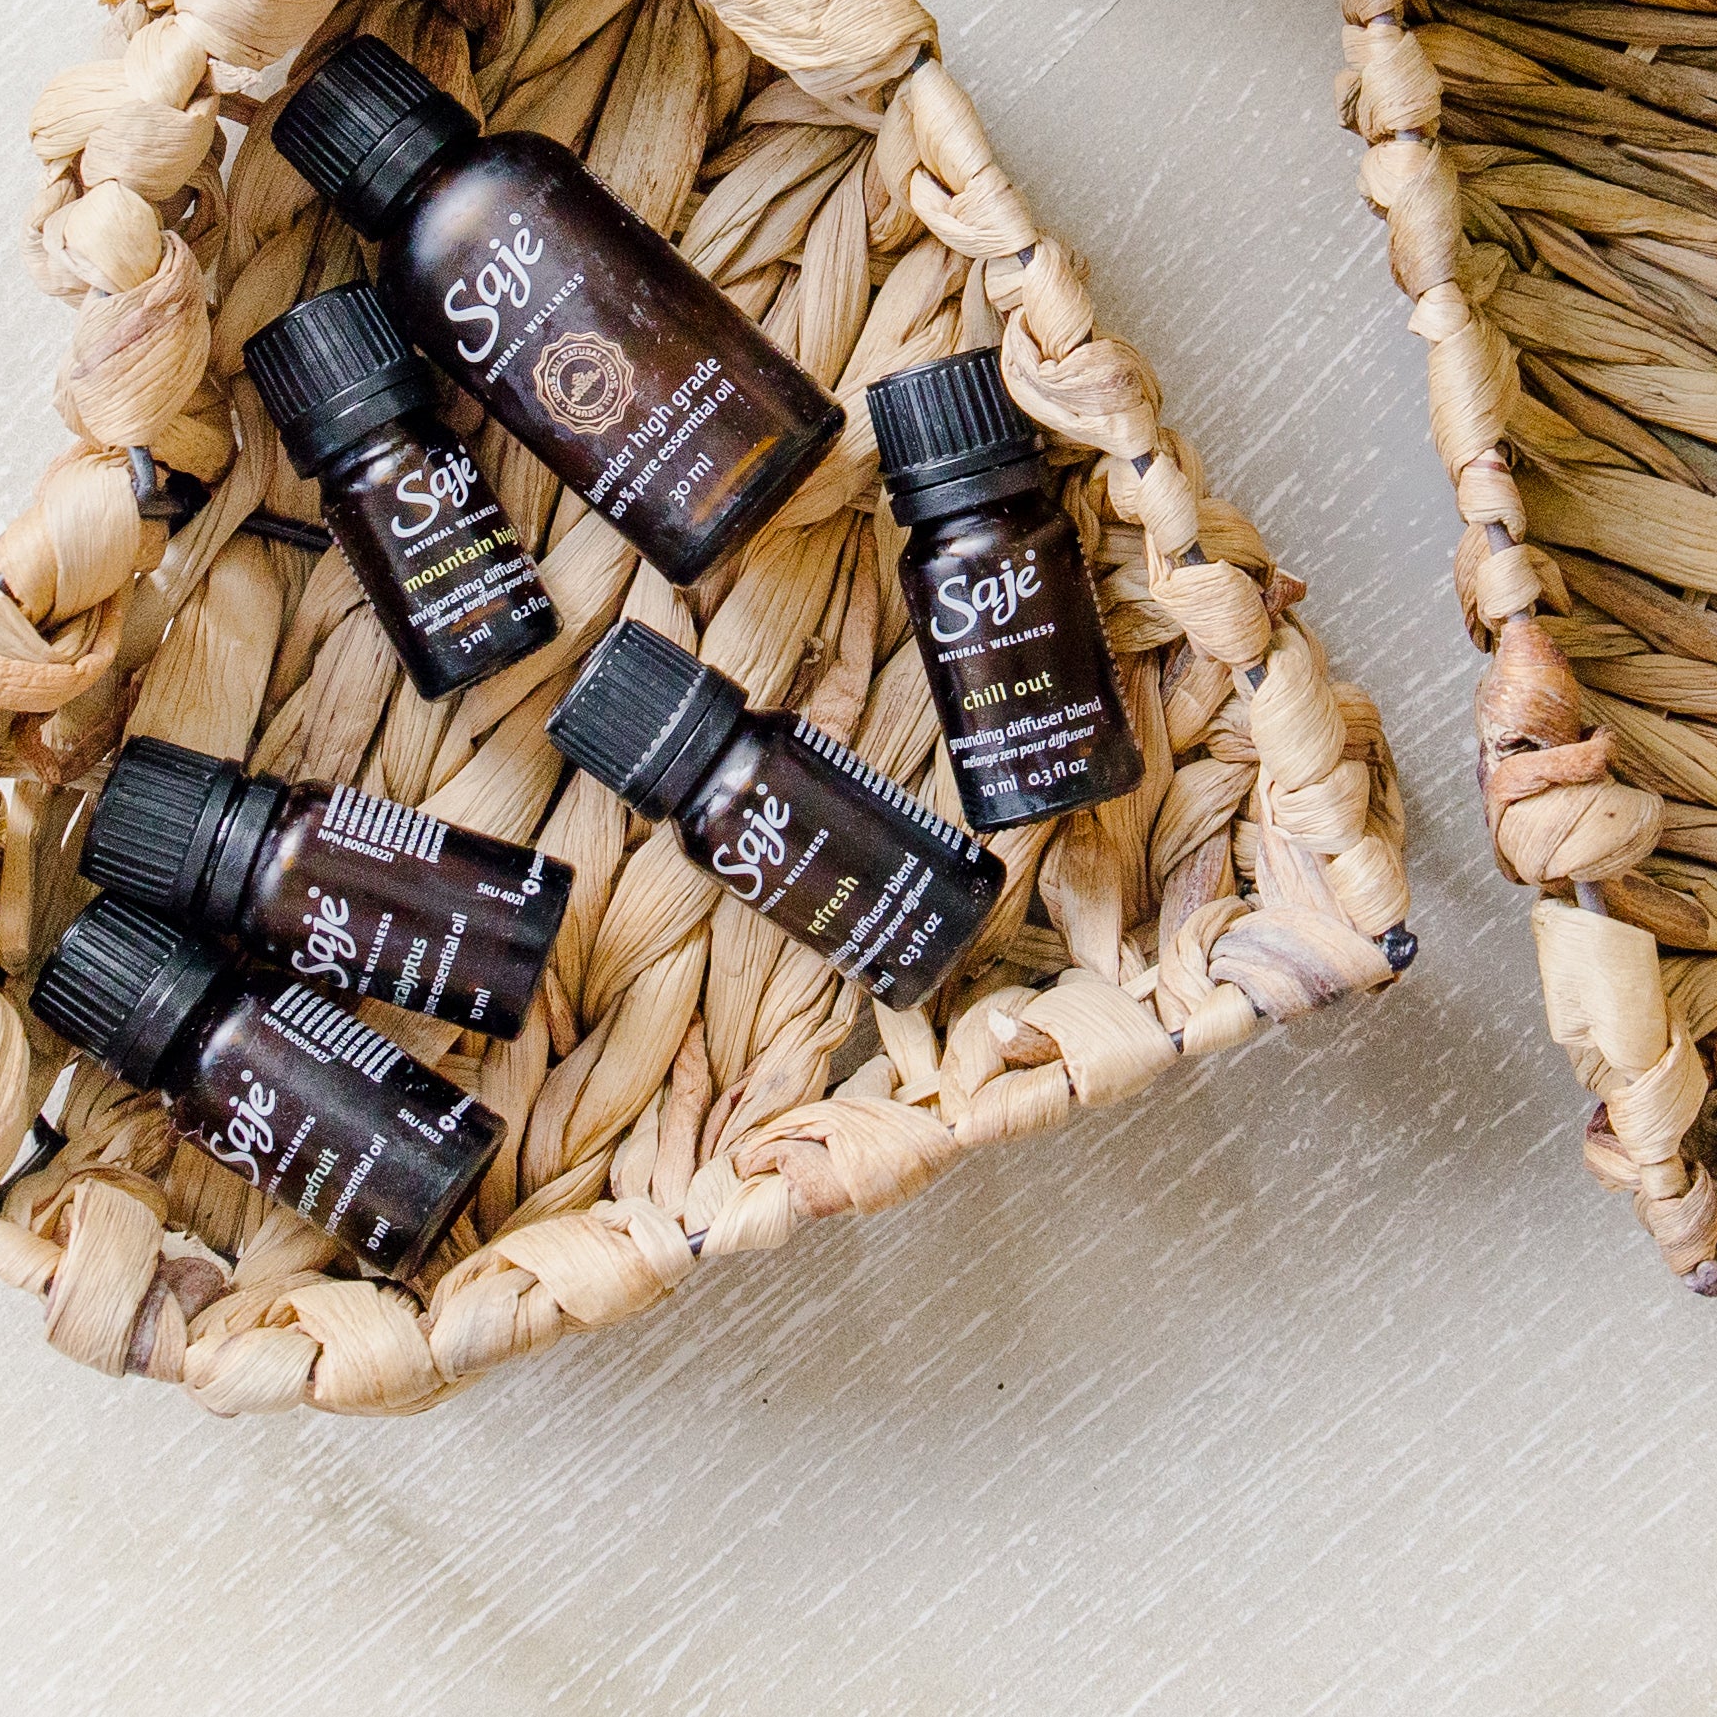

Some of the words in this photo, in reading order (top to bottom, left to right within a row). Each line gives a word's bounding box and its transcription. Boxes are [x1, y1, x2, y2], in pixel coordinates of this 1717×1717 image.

[444, 227, 544, 363] Saje
[485, 336, 526, 385] NATURAL
[523, 272, 585, 335] WELLNESS
[560, 347, 603, 362] NATURAL
[584, 444, 635, 505] lavender
[626, 404, 674, 449] high
[671, 357, 722, 412] grade
[630, 458, 662, 496] pure
[658, 395, 719, 461] essential
[714, 378, 736, 402] oil
[391, 452, 478, 538] Saje
[668, 480, 691, 508] 30
[687, 452, 715, 483] ml
[402, 537, 495, 594] mountain
[491, 524, 519, 546] hig
[403, 526, 455, 559] NATURAL
[455, 503, 499, 530] WELLNESS
[407, 577, 486, 628] invigorating
[483, 556, 524, 584] diffuser
[510, 605, 532, 623] 0.2
[528, 596, 540, 613] fl
[537, 595, 550, 609] oz
[930, 560, 1042, 643] Saje
[459, 637, 472, 654] 5
[469, 622, 493, 645] ml
[937, 643, 986, 663] NATURAL
[989, 622, 1056, 650] WELLNESS
[963, 682, 1008, 711] chill
[1014, 670, 1053, 696] out
[1006, 711, 1063, 738] diffuser
[1064, 695, 1103, 721] blend
[999, 747, 1018, 762] zen
[1019, 739, 1047, 760] pour
[1047, 724, 1095, 750] diffuseur
[980, 783, 996, 798] 10
[996, 774, 1019, 795] ml
[1027, 768, 1053, 787] 0.3
[1052, 760, 1067, 779] fl
[1068, 758, 1089, 774] oz
[317, 827, 344, 846] NPN
[342, 837, 395, 863] 80036221
[712, 795, 790, 901] Saje
[783, 828, 830, 886] WELLNESS
[476, 882, 501, 899] SKU
[499, 888, 526, 907] 4021
[806, 876, 860, 935] refresh
[850, 891, 894, 944] diffuser
[884, 851, 920, 895] blend
[884, 911, 906, 939] pour
[900, 866, 934, 914] diffuseur
[291, 895, 357, 989] Saje
[364, 912, 393, 973] WELLNESS
[430, 933, 461, 995] essential
[451, 911, 469, 935] oil
[898, 944, 922, 966] 0.3
[911, 929, 929, 946] fl
[923, 912, 944, 934] oz
[474, 986, 492, 1009] ml
[870, 982, 885, 995] 10
[877, 970, 896, 989] ml
[261, 1012, 286, 1034] NPN
[282, 1027, 332, 1064] 80036427
[469, 1007, 485, 1021] 10
[209, 1081, 276, 1187] Saje
[276, 1114, 317, 1173] WELLNESS
[396, 1108, 421, 1129] SKU
[417, 1122, 444, 1145] 4023
[334, 1153, 376, 1214] essential
[369, 1133, 389, 1157] oil
[366, 1236, 381, 1251] 10
[372, 1215, 391, 1235] ml
